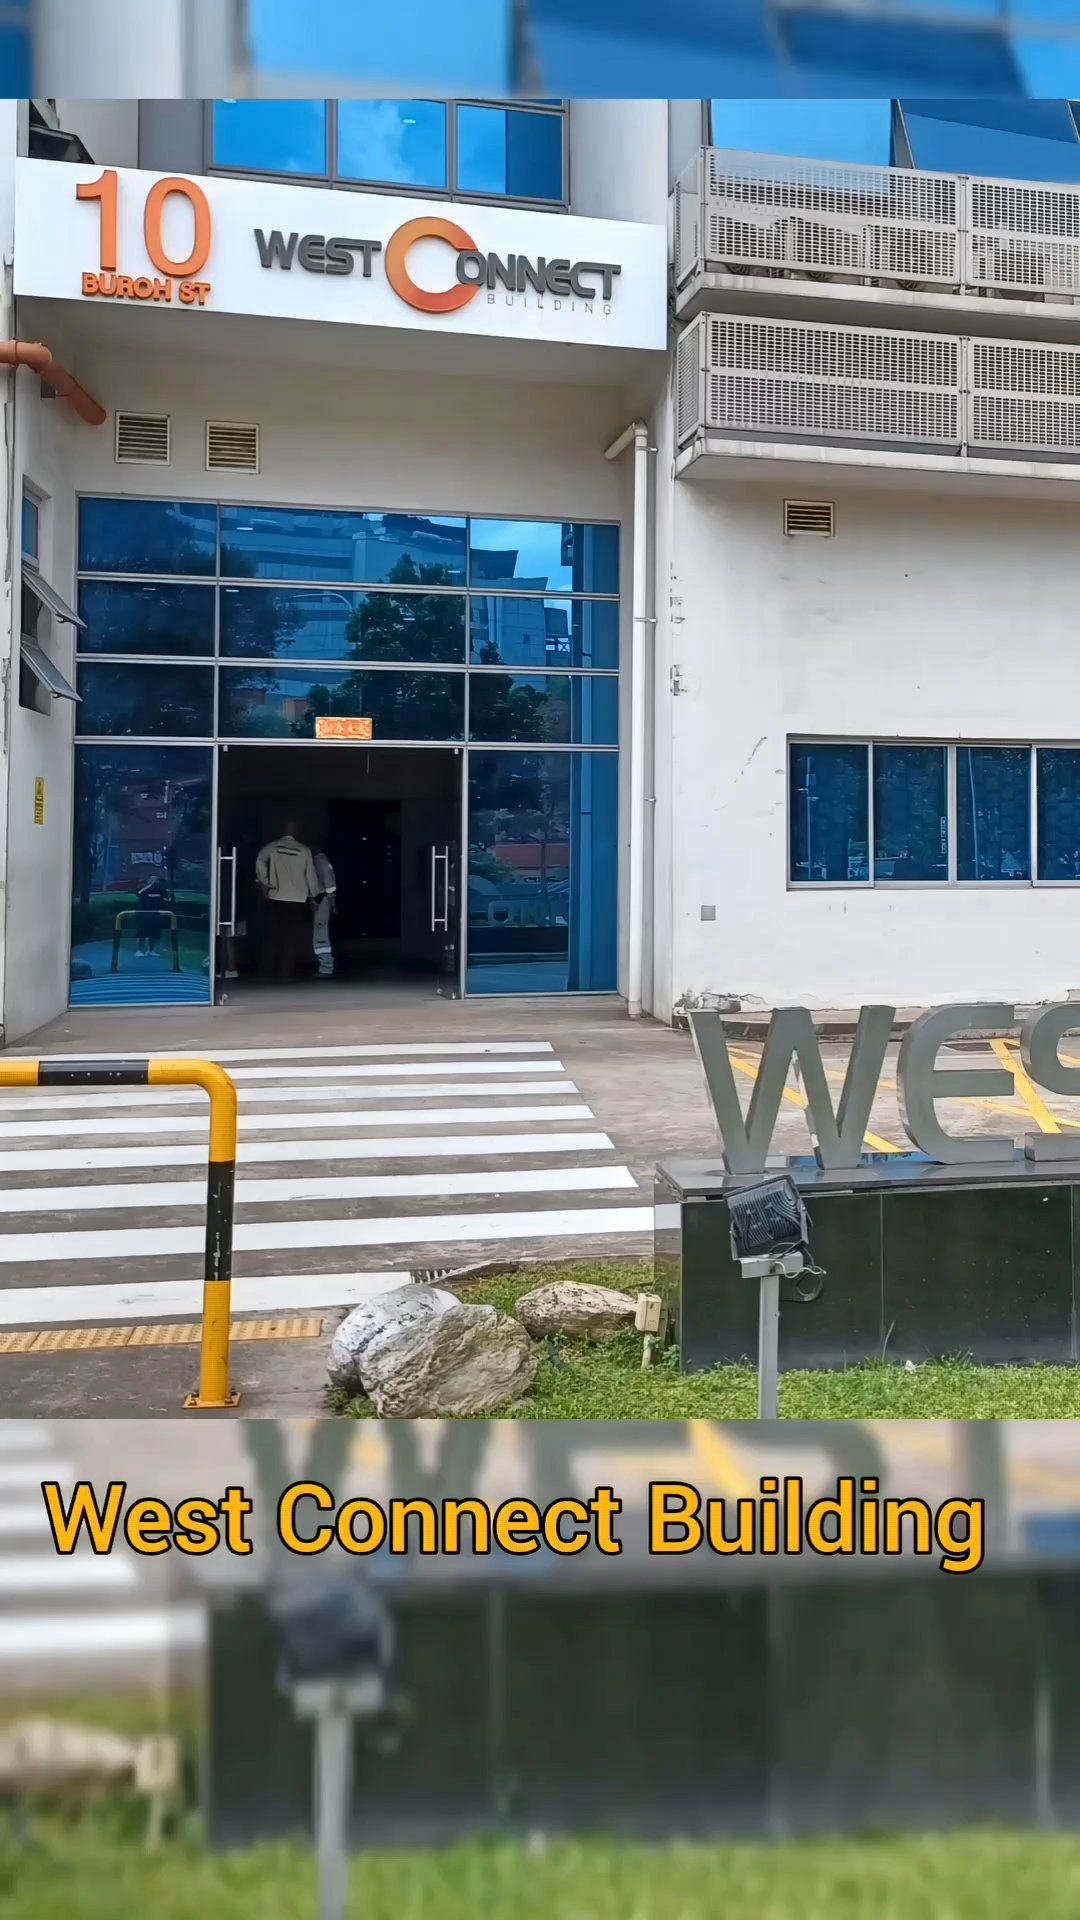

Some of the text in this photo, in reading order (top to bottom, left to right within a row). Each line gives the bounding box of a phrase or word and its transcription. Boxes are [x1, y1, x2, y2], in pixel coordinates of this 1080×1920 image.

[76, 170, 212, 280] 10
[82, 271, 211, 306] BUROH ST
[486, 292, 613, 316] BUILDING
